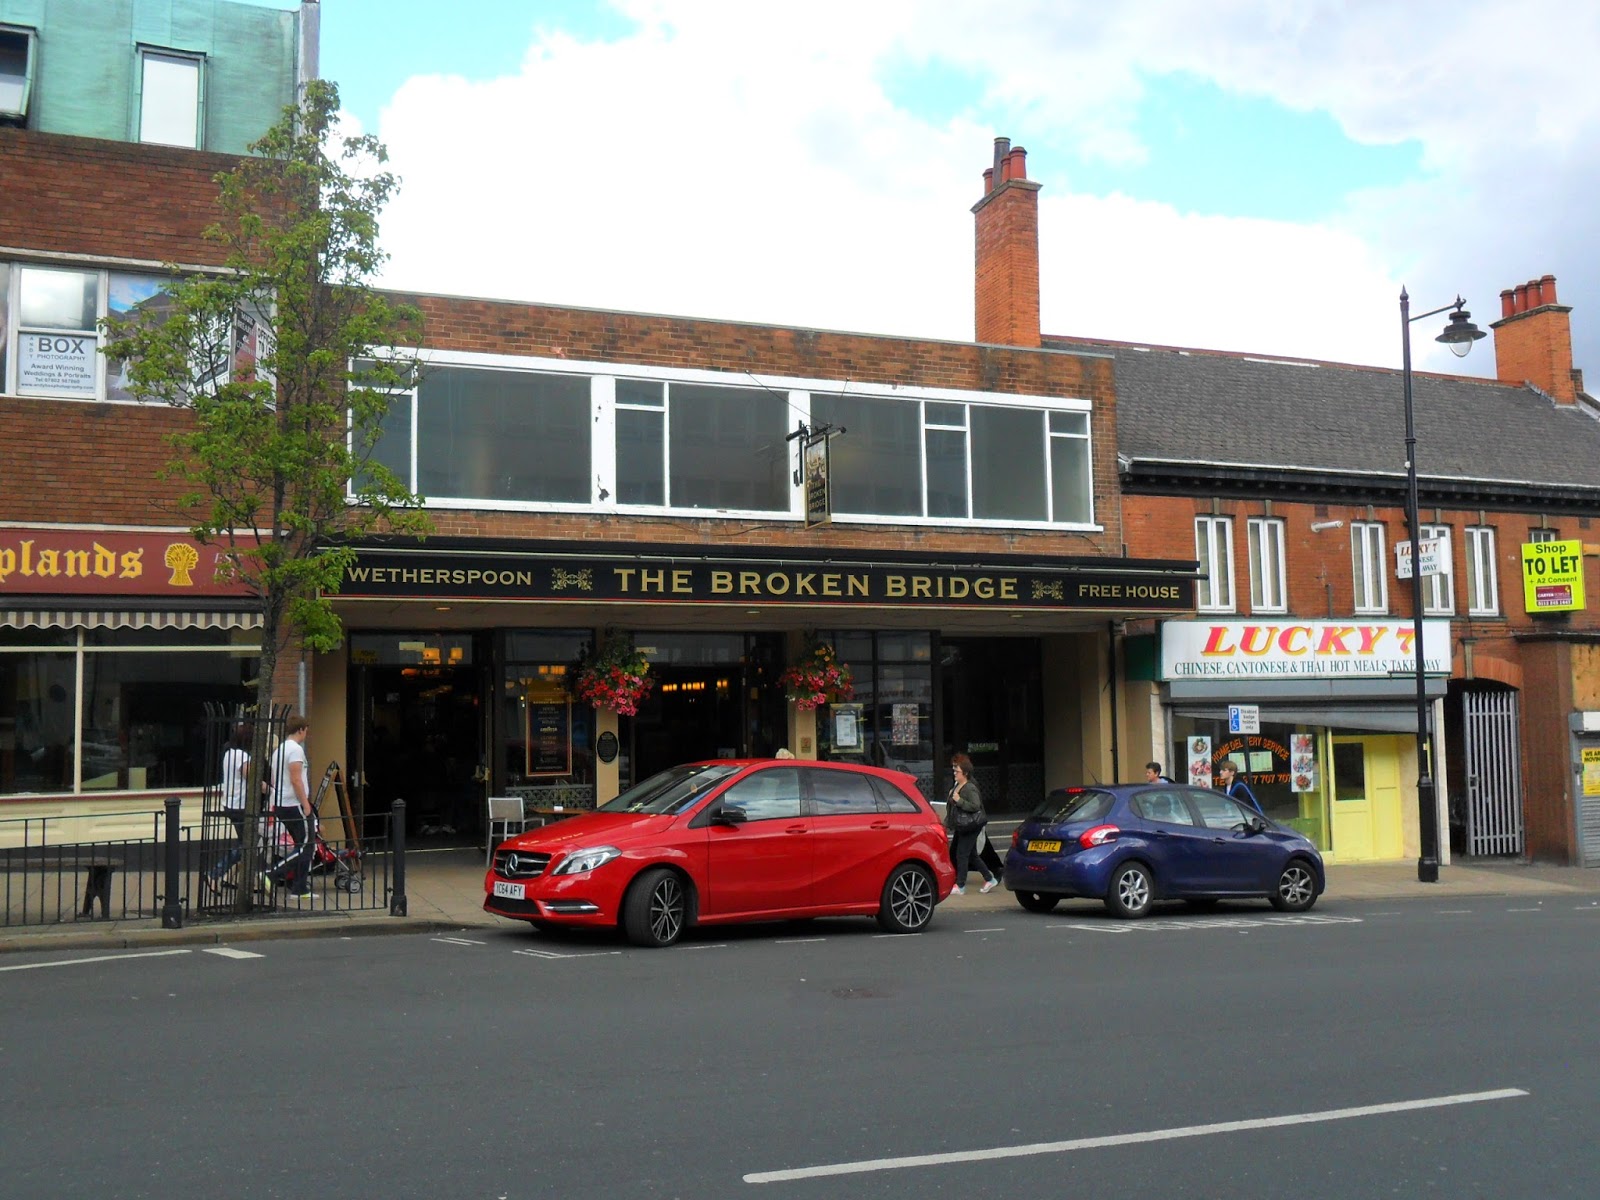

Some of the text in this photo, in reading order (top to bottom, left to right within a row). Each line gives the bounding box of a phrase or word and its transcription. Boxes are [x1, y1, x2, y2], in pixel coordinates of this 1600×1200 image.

[38, 337, 85, 354] BOX
[24, 370, 56, 378] Weddings
[55, 364, 85, 373] Winning
[1400, 543, 1430, 556] LUKY
[1535, 544, 1567, 555] Shop
[1525, 556, 1579, 576] TO LET
[347, 567, 1180, 600] WETHERSPOON THE BROKEN BRIDGE FREE HOUSE
[1547, 576, 1578, 584] Consent
[1200, 625, 1417, 657] LUCKY 7
[1174, 660, 1441, 676] CHINESE, CANTONESE & THAI HOT MEALS TAKEWAY
[1212, 737, 1290, 763] HOME DELERY SERVICE
[1043, 842, 1057, 850] PTZ
[509, 884, 523, 897] AFY
